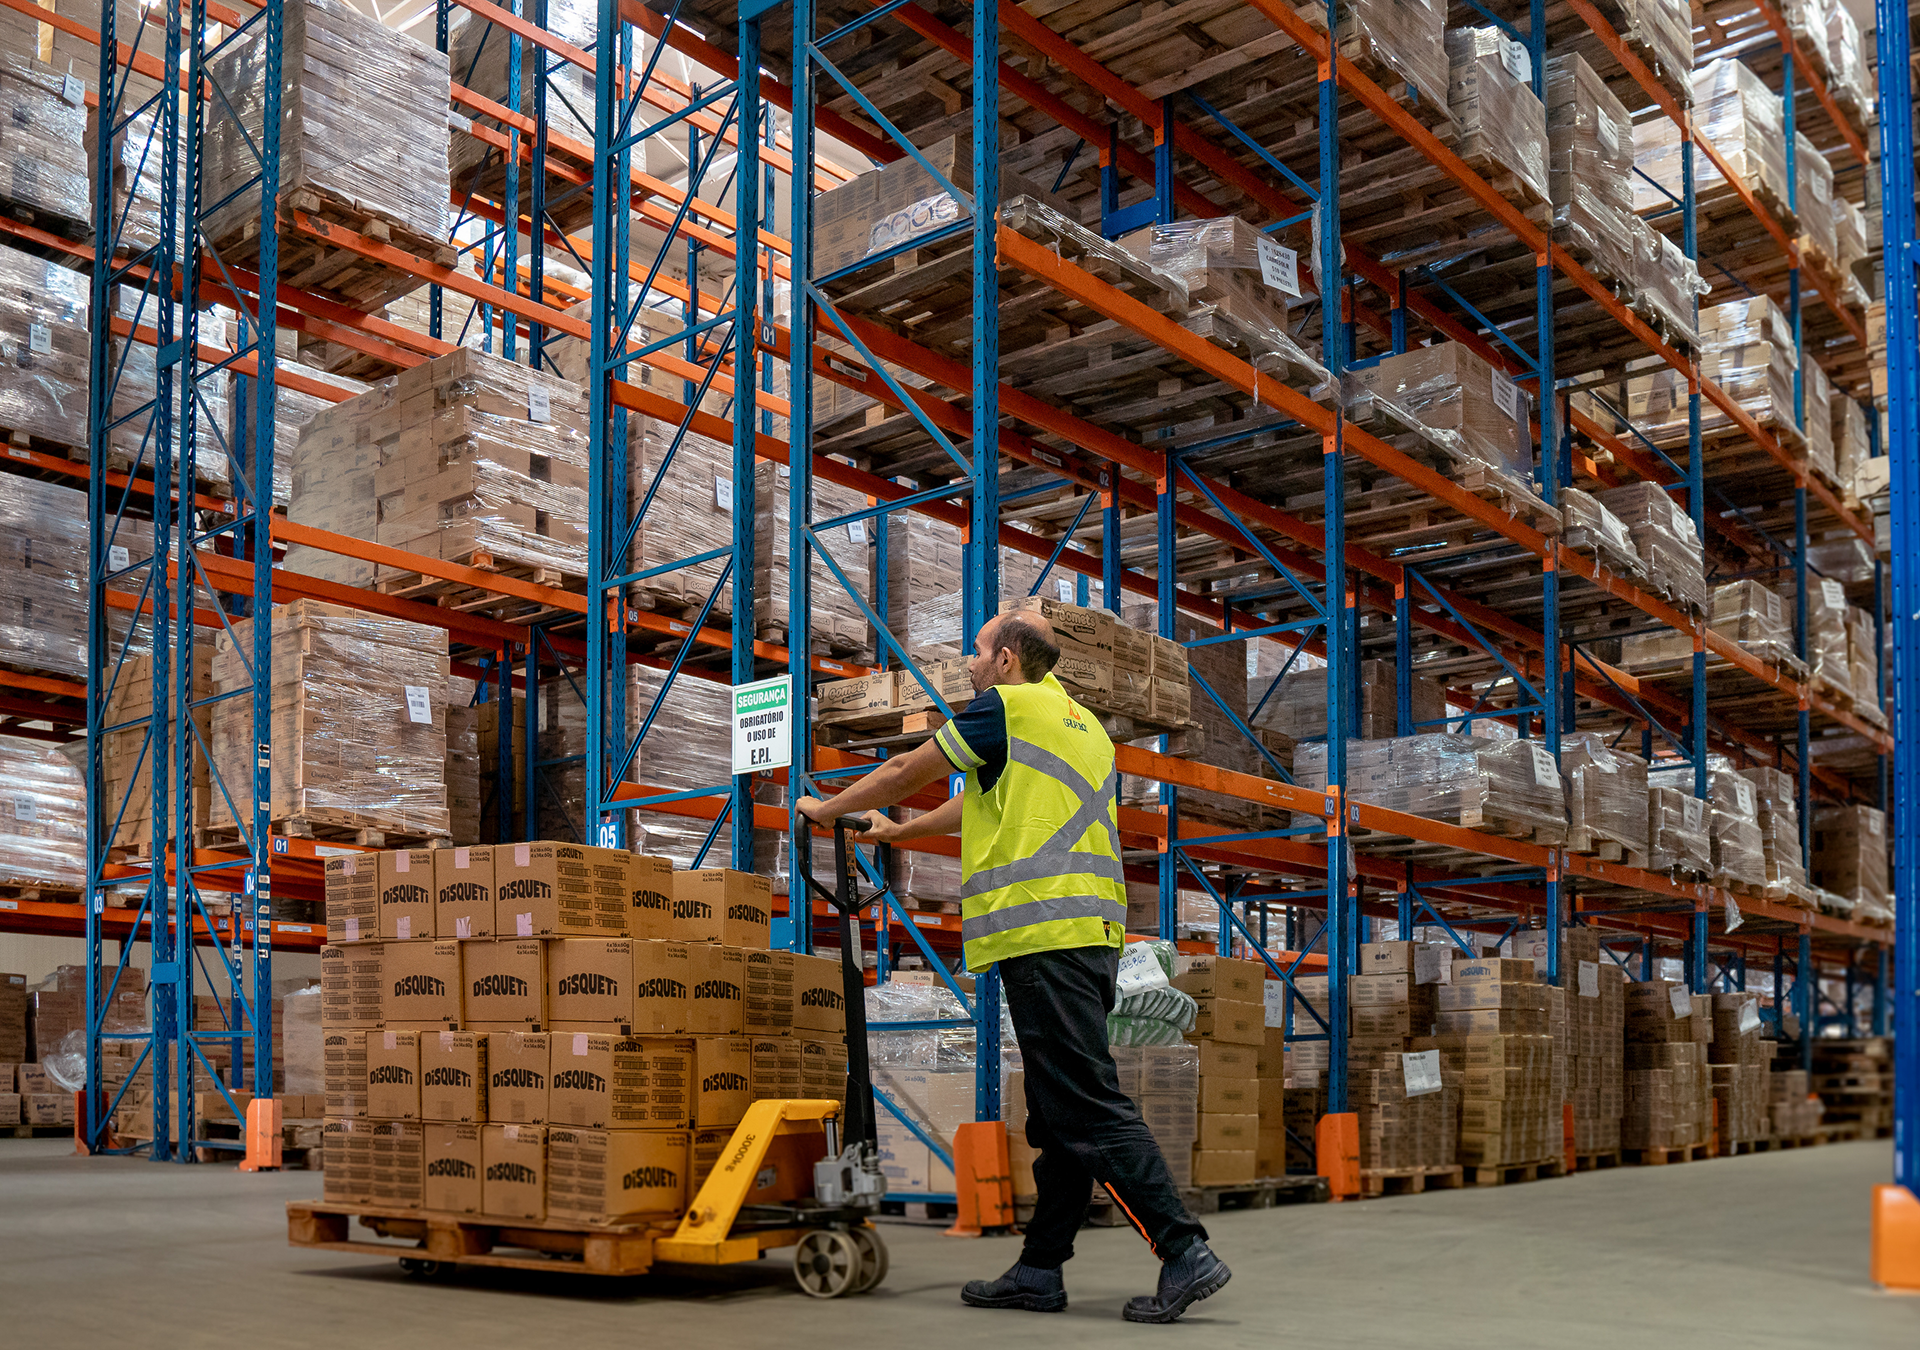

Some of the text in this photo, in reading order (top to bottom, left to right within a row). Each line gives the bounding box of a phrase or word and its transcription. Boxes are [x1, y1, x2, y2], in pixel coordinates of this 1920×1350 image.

[763, 326, 774, 344] 01
[1100, 472, 1109, 486] 02
[224, 504, 234, 513] 23
[628, 610, 638, 622] 05
[515, 642, 524, 652] 07
[738, 688, 786, 708] SEGURANÇA
[740, 710, 783, 729] OBRIGATÓRIO
[747, 727, 776, 742] O USO DE
[751, 747, 771, 765] E.P.I.
[1325, 802, 1334, 814] 02
[1351, 806, 1359, 821] 03
[600, 825, 616, 849] 05
[275, 840, 288, 852] 01
[94, 896, 103, 912] 03
[245, 921, 253, 929] 03
[1191, 959, 1207, 967] dori
[1375, 951, 1392, 960] dori
[395, 975, 444, 997] DiSQUETi
[474, 974, 527, 997] DiSQUETi
[558, 973, 618, 996] DiSQUETi
[493, 1068, 544, 1089] DiSQUETi
[554, 1070, 606, 1092] DiSQUETi
[623, 1167, 677, 1190] DiSQUETi
